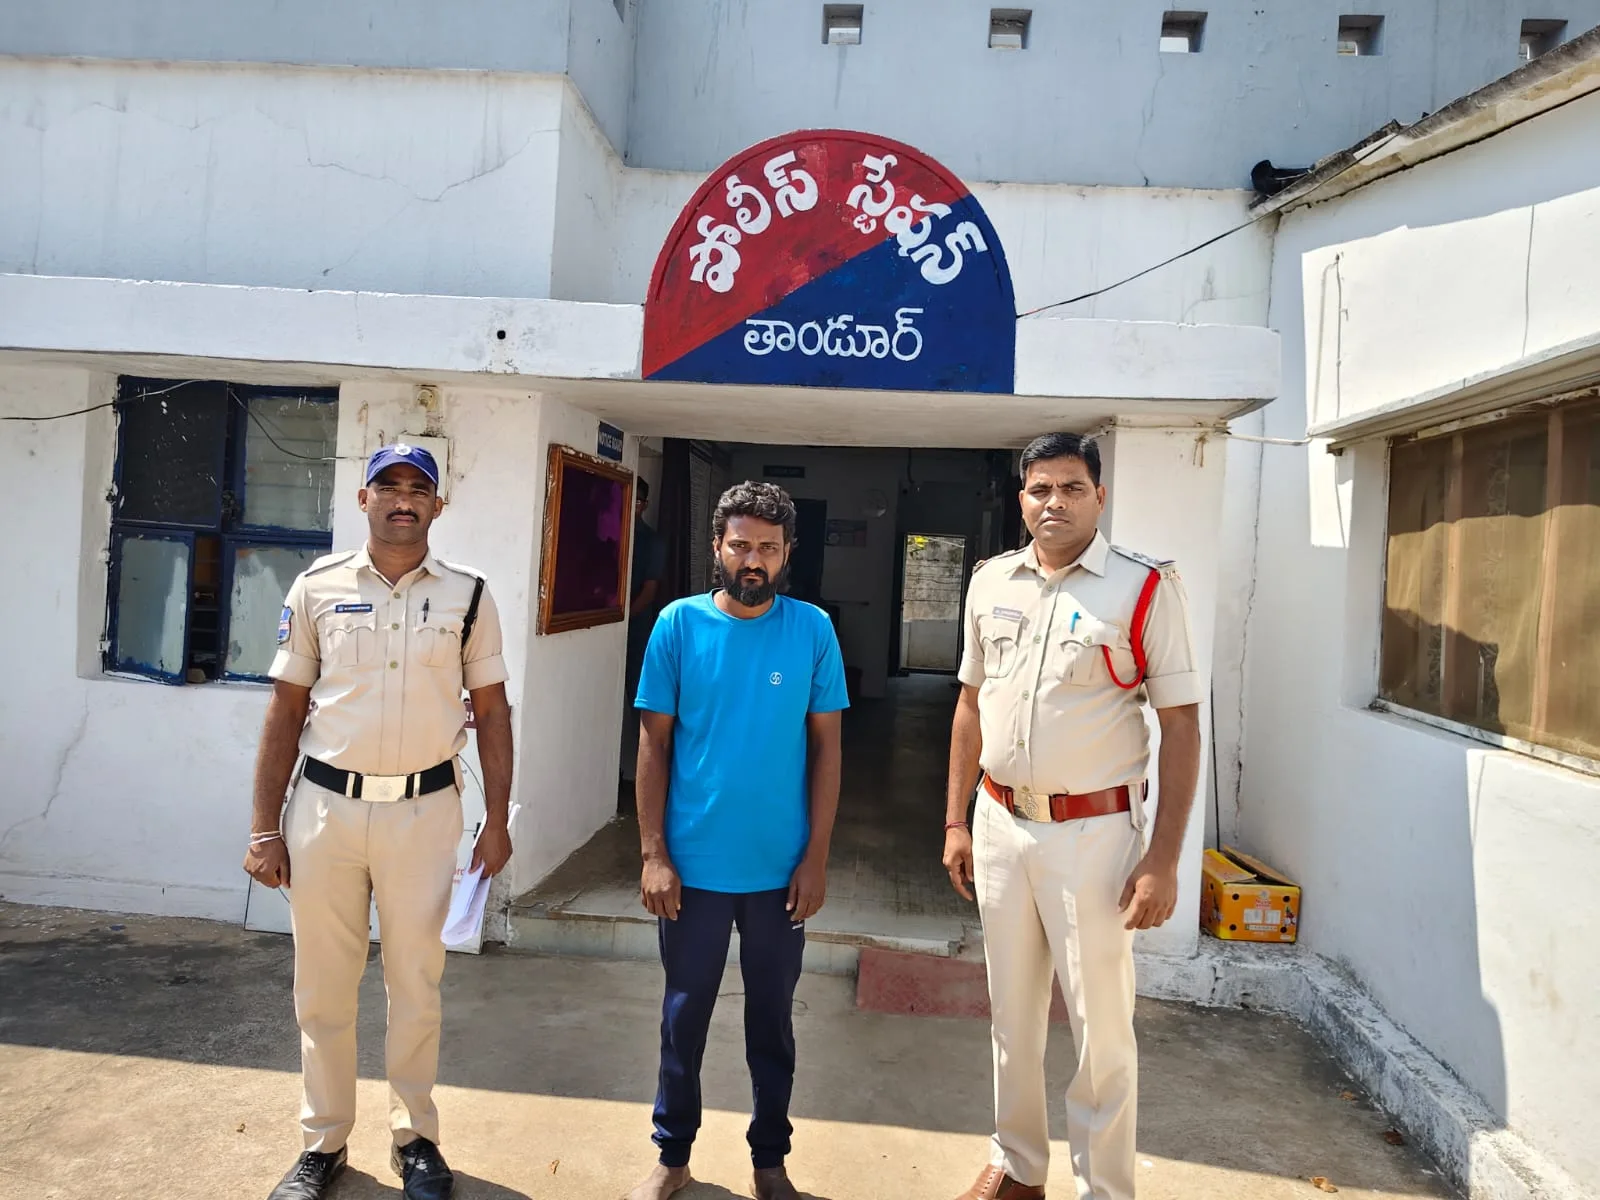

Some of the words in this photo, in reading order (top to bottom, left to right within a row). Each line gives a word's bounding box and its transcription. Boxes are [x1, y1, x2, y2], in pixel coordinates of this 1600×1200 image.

[689, 150, 819, 293] పోలీస్
[846, 153, 988, 285] స్టేషన్
[743, 307, 924, 361] తాండూర్
[599, 431, 612, 448] NOTICE
